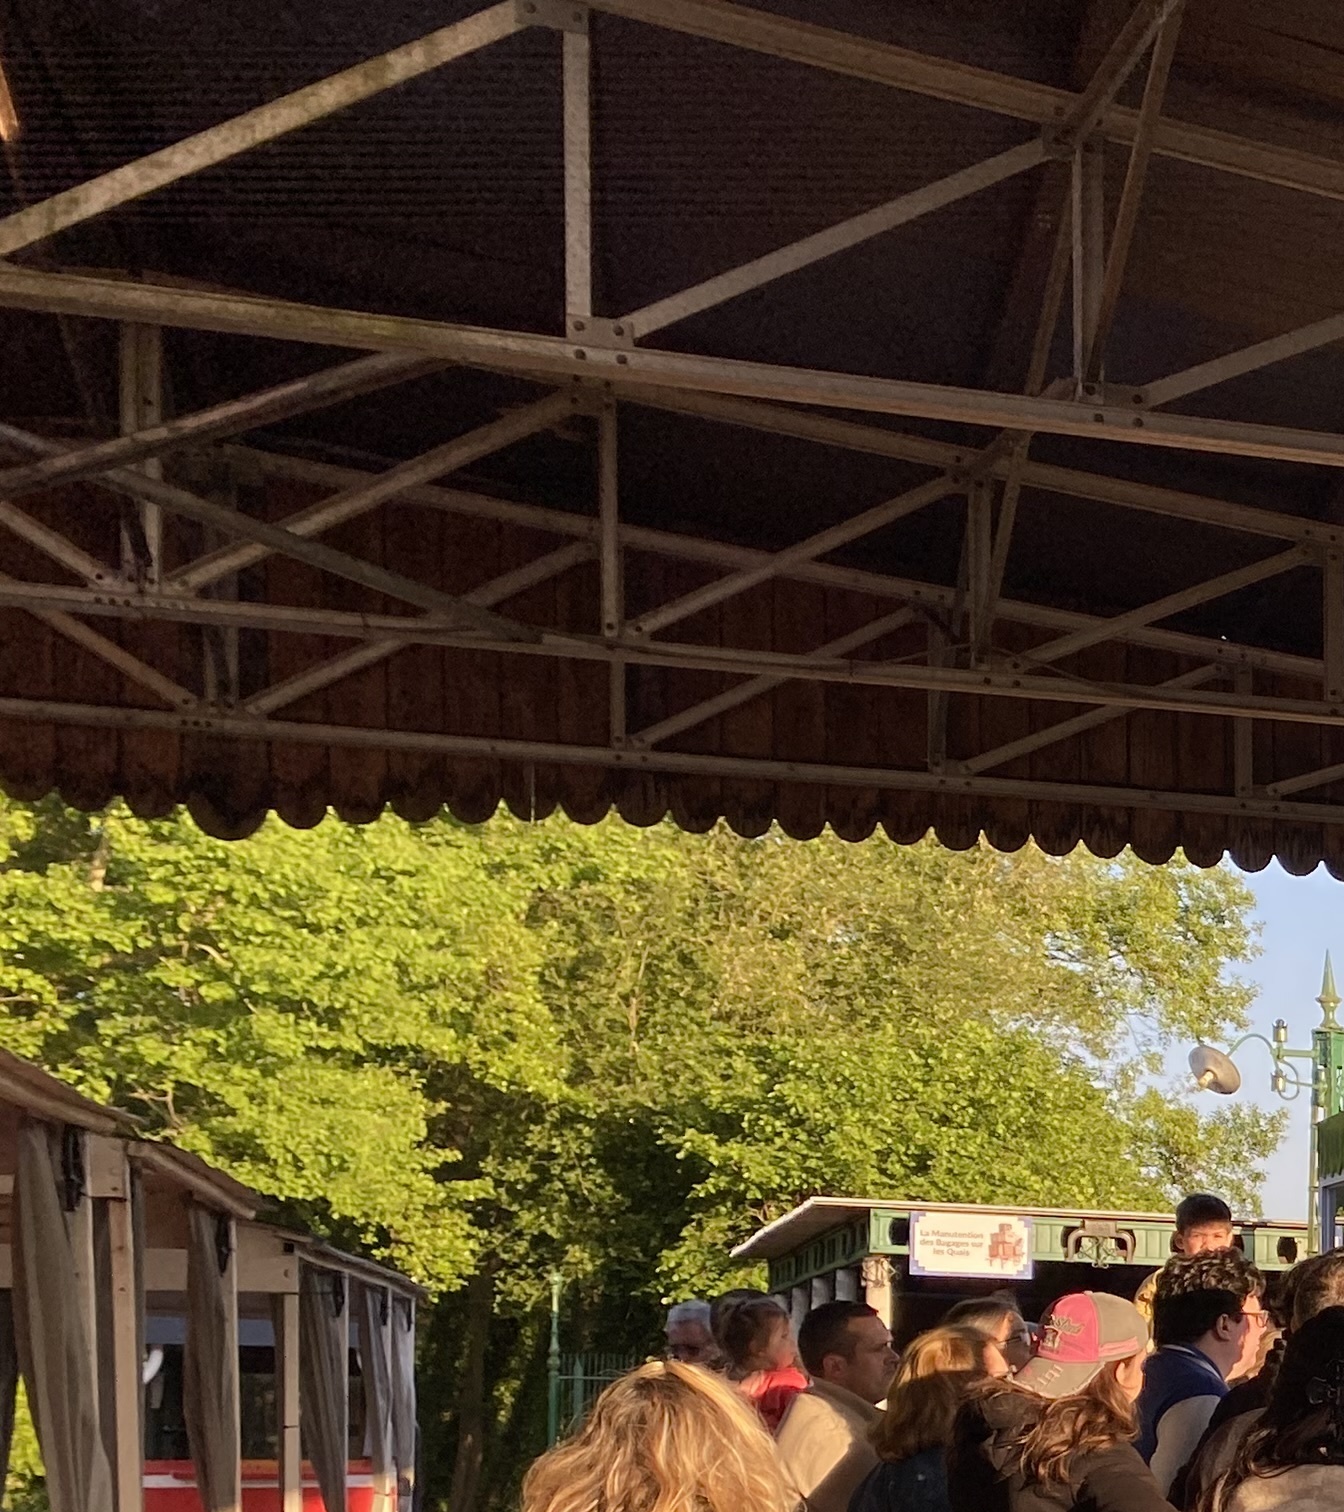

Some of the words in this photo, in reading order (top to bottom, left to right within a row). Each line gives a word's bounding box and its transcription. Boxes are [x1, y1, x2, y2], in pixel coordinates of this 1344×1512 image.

[919, 1229, 930, 1237] La
[931, 1230, 984, 1239] Manutention
[919, 1238, 934, 1246] des
[935, 1238, 970, 1249] Bagages
[932, 1247, 945, 1255] les
[946, 1248, 970, 1257] Quais
